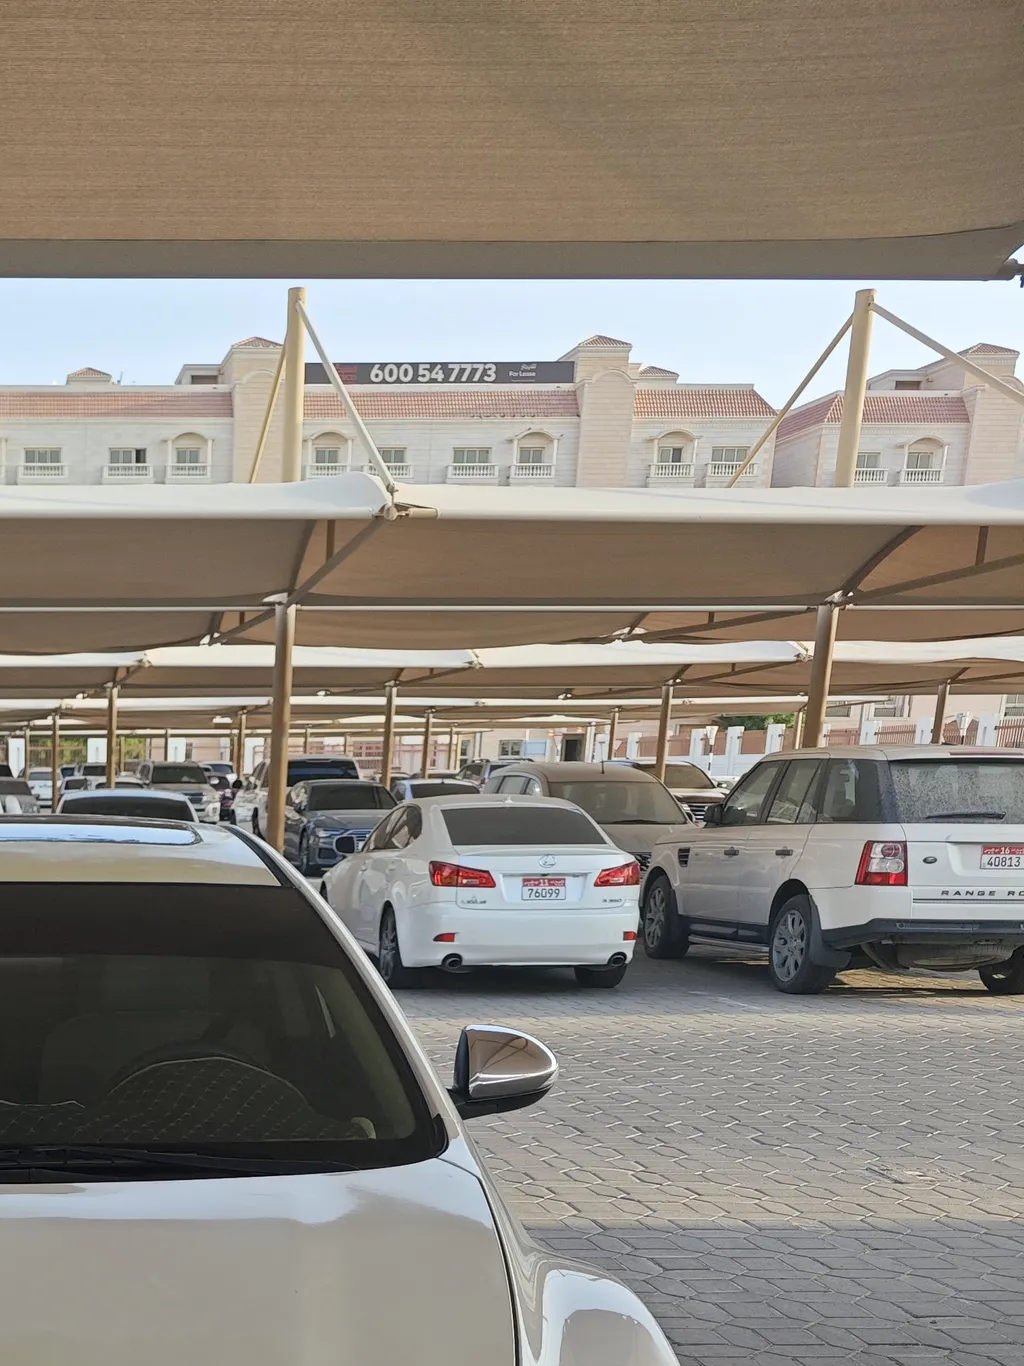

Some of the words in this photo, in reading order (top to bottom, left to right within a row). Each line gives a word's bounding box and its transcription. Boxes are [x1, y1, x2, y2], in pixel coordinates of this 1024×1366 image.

[369, 363, 414, 383] 600
[417, 363, 445, 383] 54
[448, 363, 497, 382] 7773
[508, 370, 519, 378] For
[519, 370, 537, 378] Lease
[1000, 846, 1010, 855] 16
[986, 856, 1021, 867] 40813
[527, 888, 561, 898] 76099
[940, 889, 997, 897] RANGE
